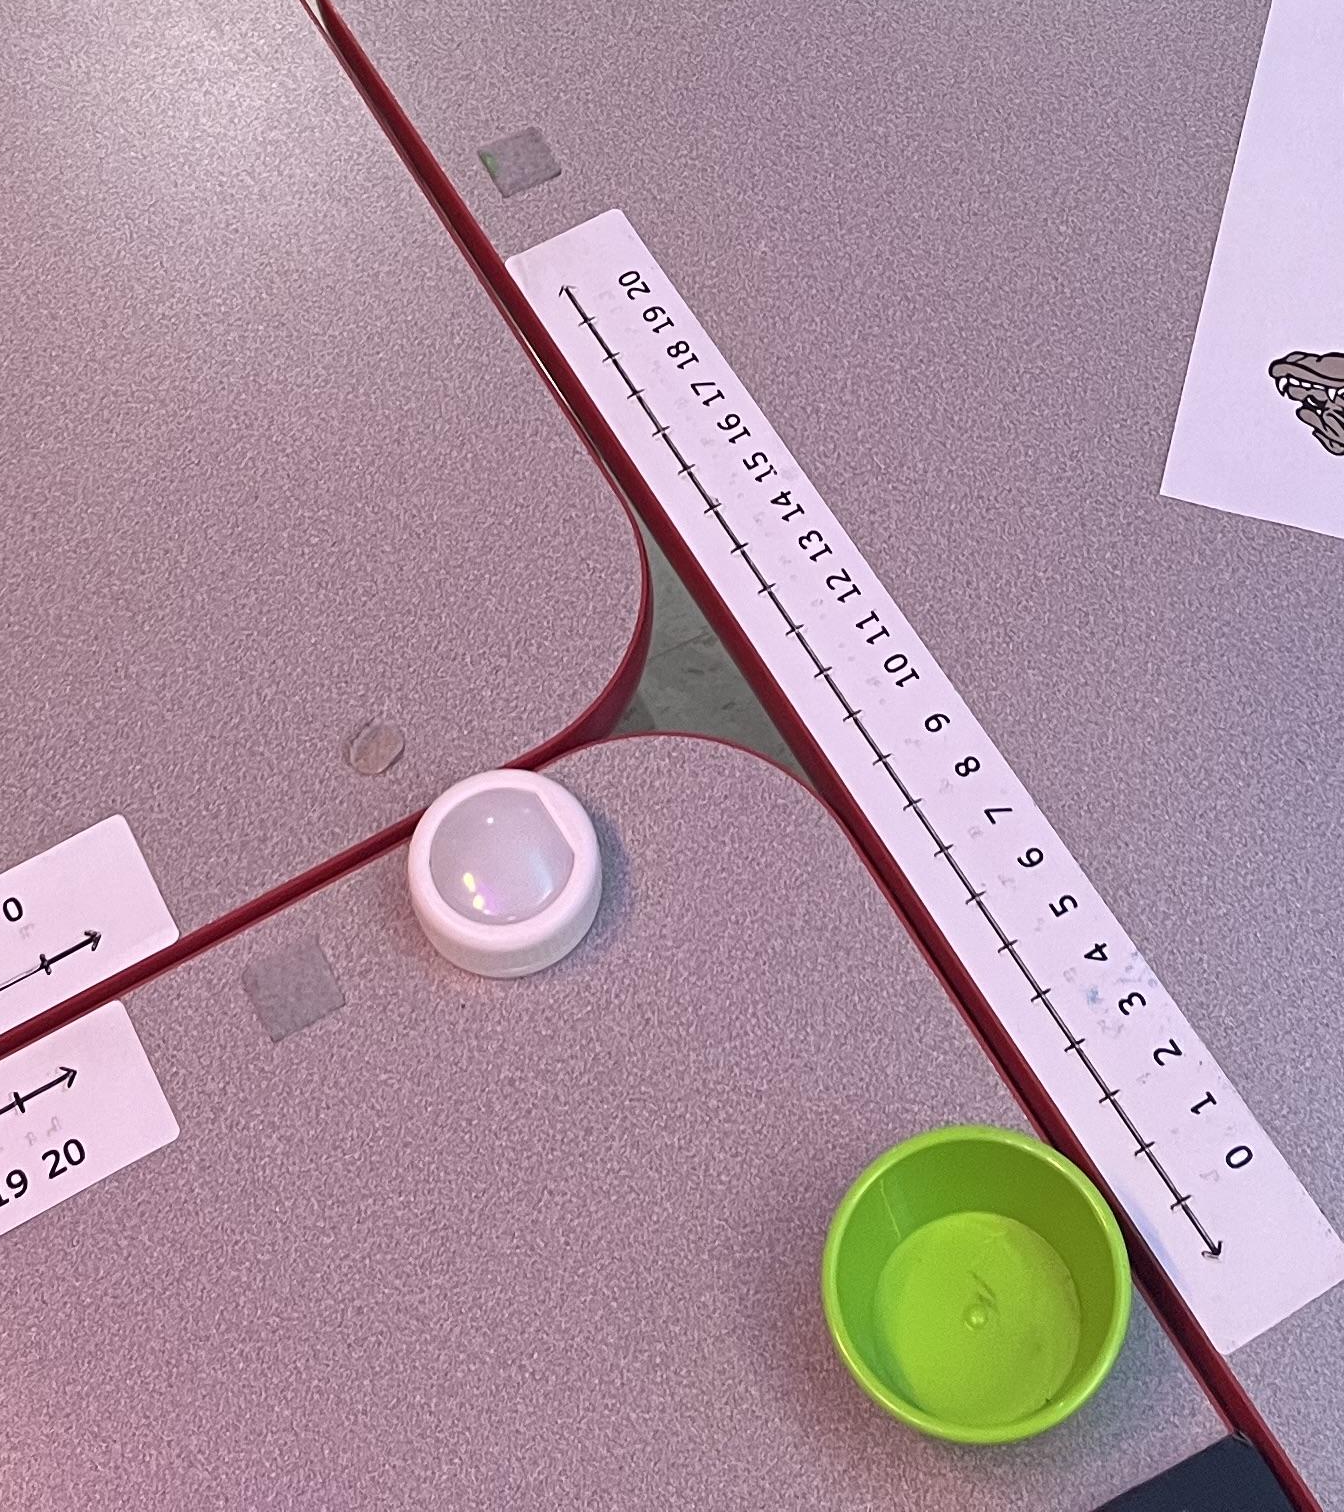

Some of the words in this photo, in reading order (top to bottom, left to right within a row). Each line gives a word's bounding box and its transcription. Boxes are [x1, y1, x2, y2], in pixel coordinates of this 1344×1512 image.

[618, 270, 651, 301] 20
[642, 306, 675, 334] 19
[666, 340, 700, 370] 18
[690, 381, 726, 407] 17
[716, 413, 751, 444] 16
[742, 451, 774, 483] 15
[770, 490, 805, 522] 14
[798, 530, 833, 562] 13
[825, 567, 862, 604] 12
[855, 610, 890, 645] 11
[883, 653, 920, 688] 10
[924, 713, 951, 733] 9
[954, 755, 981, 778] 8
[983, 807, 1013, 825] 7
[1016, 847, 1044, 868] 6
[2, 897, 23, 922] 0
[1048, 894, 1078, 918] 5
[1083, 942, 1109, 962] 4
[1118, 991, 1147, 1016] 3
[1153, 1038, 1183, 1067] 2
[1190, 1091, 1217, 1115] 1
[41, 1138, 86, 1180] 20
[1225, 1145, 1254, 1169] 0
